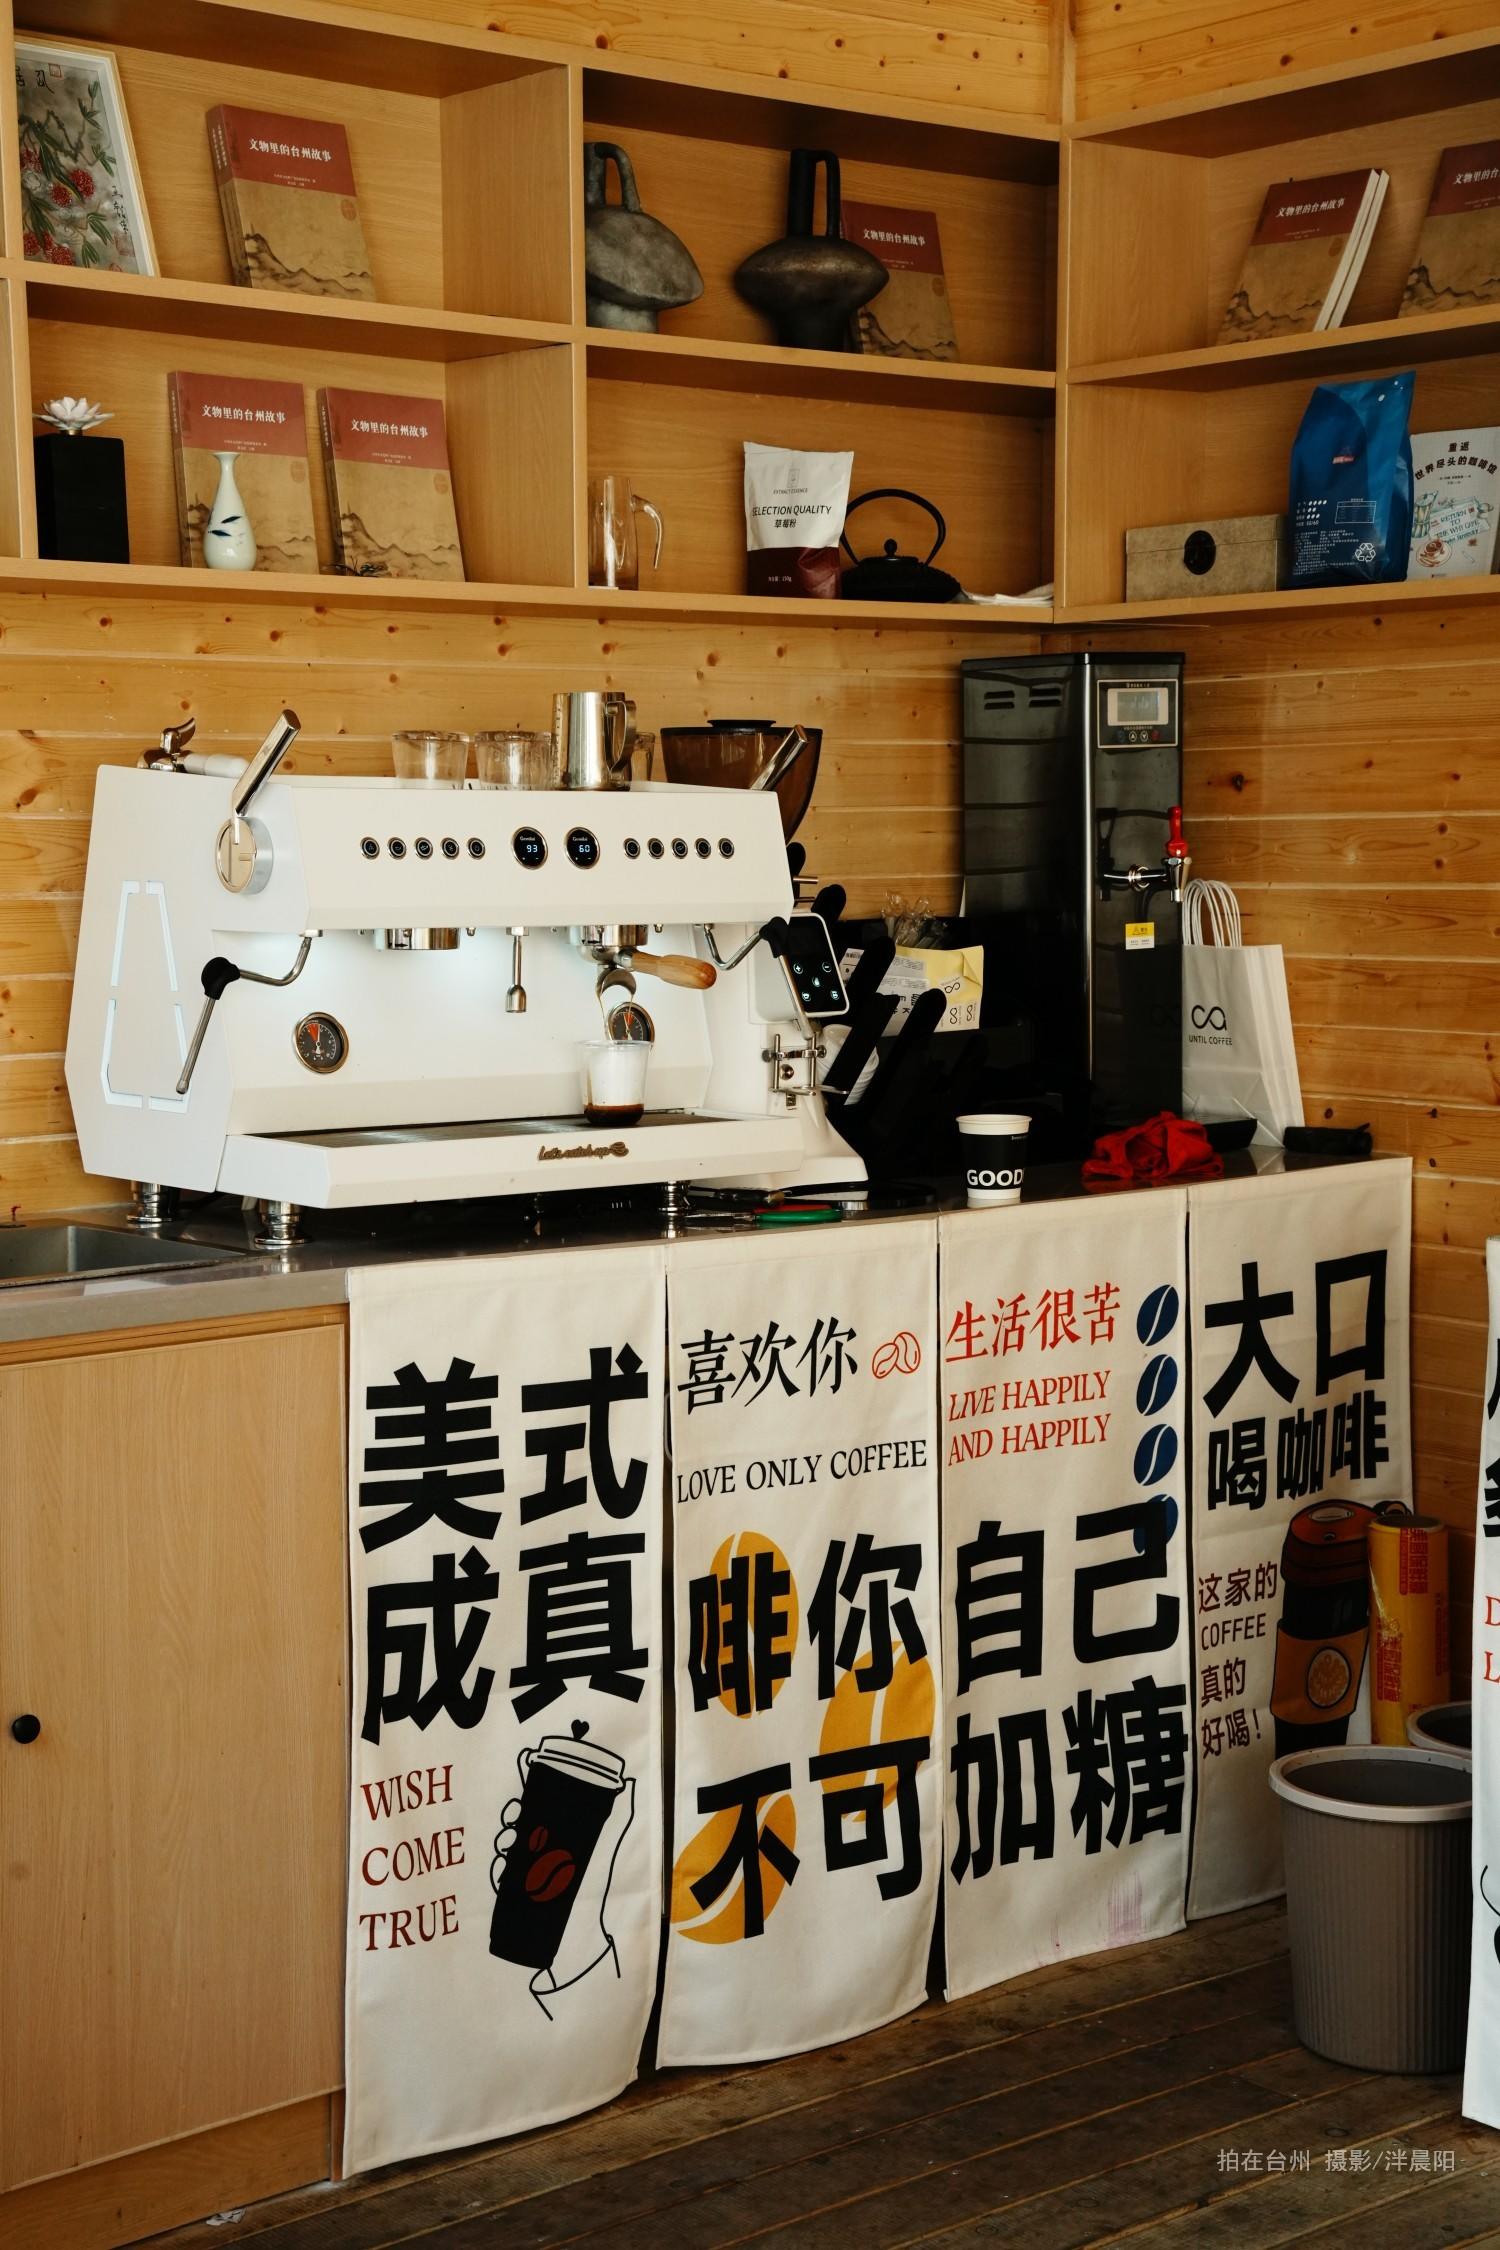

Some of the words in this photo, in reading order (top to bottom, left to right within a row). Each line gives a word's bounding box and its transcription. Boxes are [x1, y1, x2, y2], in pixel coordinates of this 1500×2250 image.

[248, 137, 332, 162] 文物里的台州故事
[1275, 197, 1346, 218] 文物里的台州故事
[863, 228, 926, 247] 文物里的台州故事
[201, 404, 287, 424] 文物里的台州故事
[351, 419, 429, 438] 文物里的台州故事
[1415, 455, 1498, 480] 世界尽头的咖啡馆
[793, 505, 832, 516] QUALITY
[526, 844, 538, 853] 93
[579, 844, 590, 853] 60
[1188, 1034, 1207, 1044] UNTIL
[1208, 1036, 1233, 1046] COFFEE
[966, 1168, 1024, 1187] GOOD
[945, 1281, 1121, 1363] 生活很苦
[1202, 1249, 1388, 1419] 大口
[677, 1316, 858, 1416] 喜欢你
[948, 1385, 997, 1422] LIVE
[1002, 1370, 1111, 1411] HAPPILY
[359, 1343, 649, 1554] 美式
[947, 1429, 994, 1466] AND
[1000, 1413, 1111, 1455] HAPPILY
[1208, 1390, 1389, 1511] 喝咖啡
[677, 1464, 736, 1504] LOVE
[746, 1455, 822, 1490] ONLY
[830, 1439, 927, 1480] COFFEE
[955, 1500, 1180, 1697] 自己
[1198, 1561, 1278, 1614] 这家的
[361, 1532, 649, 1748] 成真
[688, 1533, 928, 1717] 啡你
[1201, 1612, 1267, 1650] COFFEE
[1201, 1657, 1246, 1708] 真的
[361, 1764, 454, 1823] WISH
[950, 1674, 1189, 1886] 加糖
[361, 1826, 466, 1890] COME
[690, 1734, 932, 1941] 不可
[359, 1894, 460, 1952] TRUE
